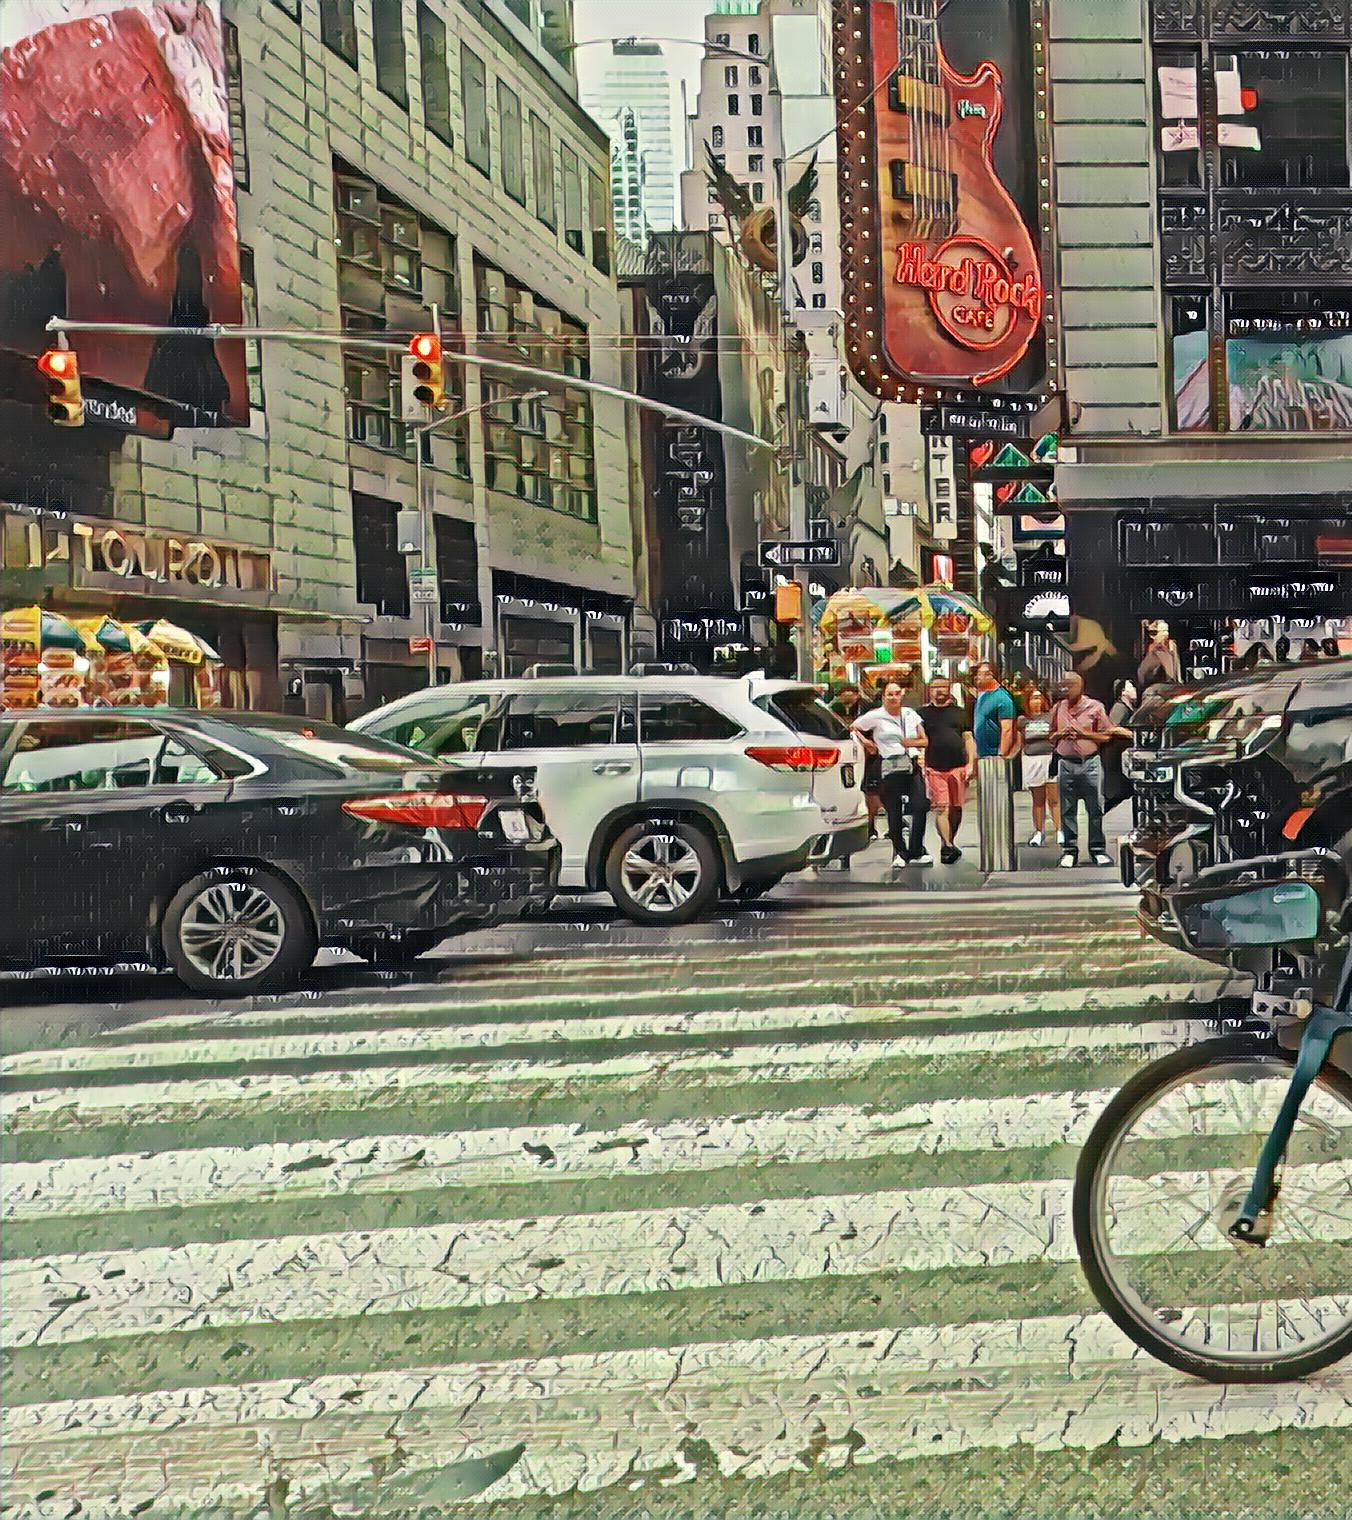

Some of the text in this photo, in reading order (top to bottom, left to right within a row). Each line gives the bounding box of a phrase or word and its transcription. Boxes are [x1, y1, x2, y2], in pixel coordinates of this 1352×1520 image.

[896, 243, 1041, 319] Hard Rock
[952, 305, 994, 331] CAFE
